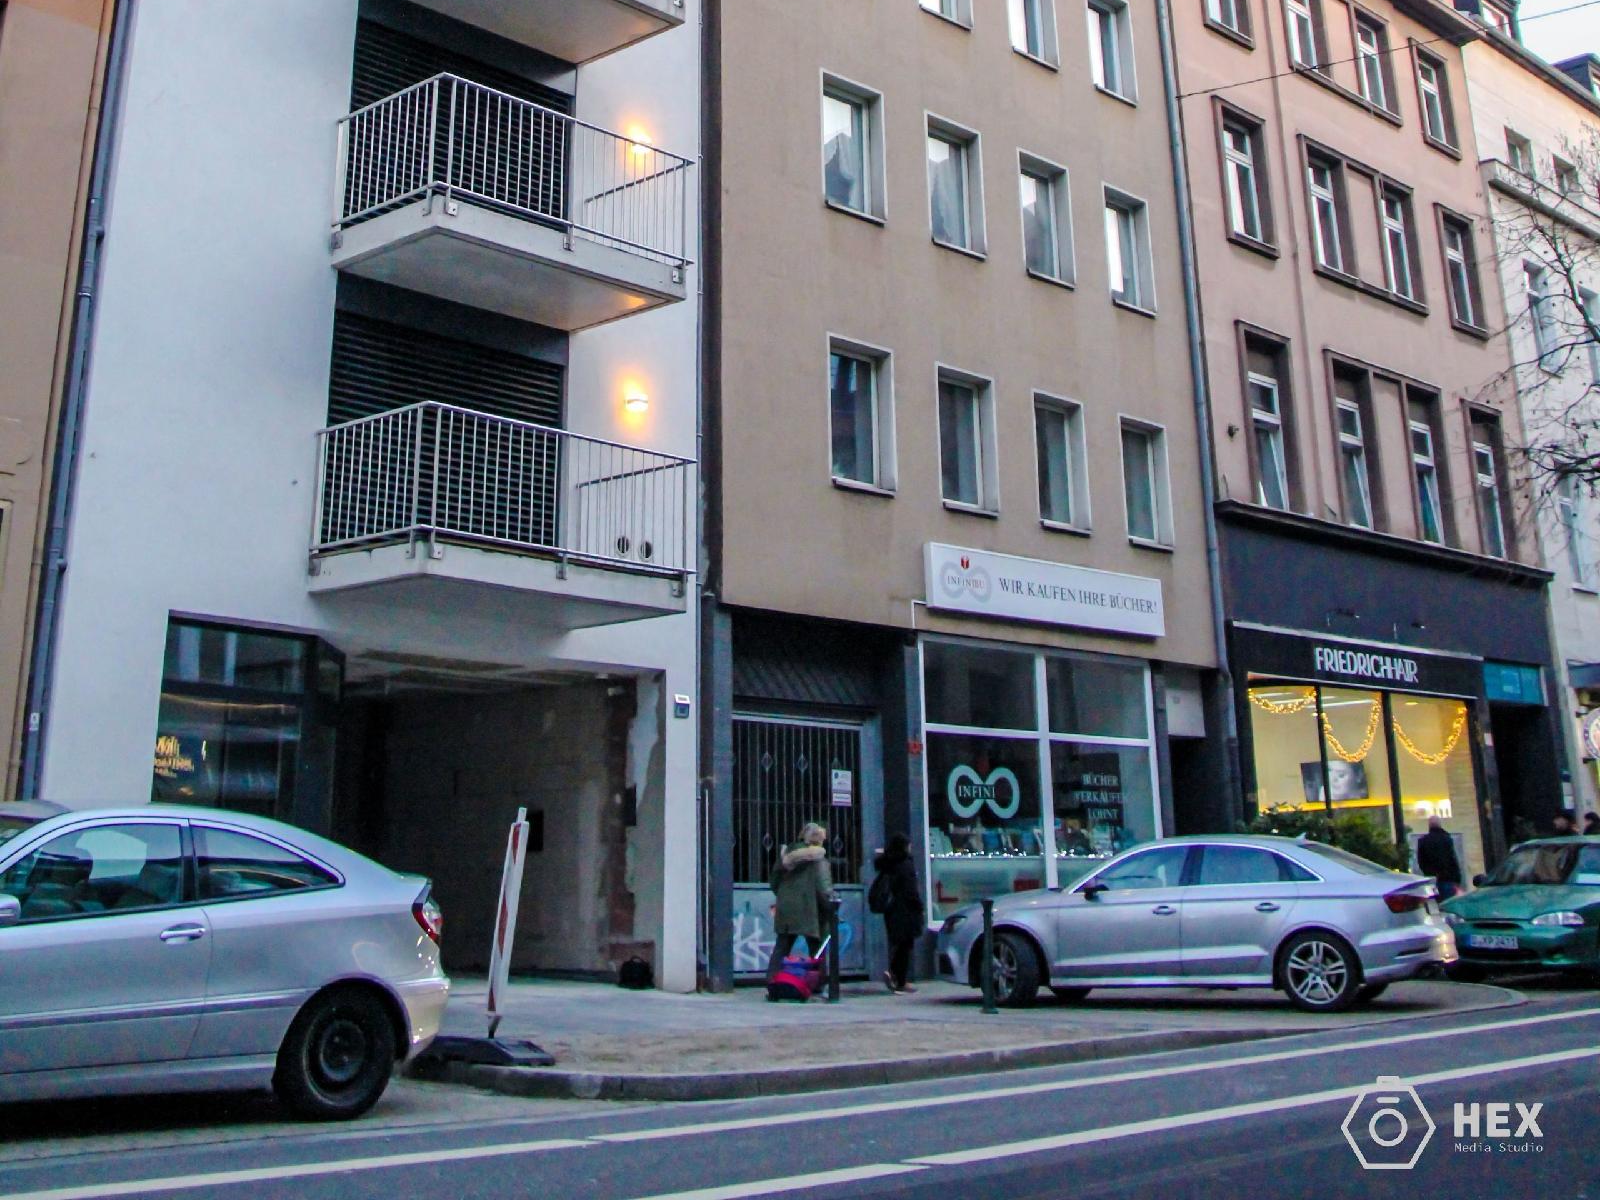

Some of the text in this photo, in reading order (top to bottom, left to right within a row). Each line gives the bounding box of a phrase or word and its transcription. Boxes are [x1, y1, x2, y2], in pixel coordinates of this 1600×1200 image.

[999, 577, 1158, 614] WIR KAUFEN IHRE BÜCHER!
